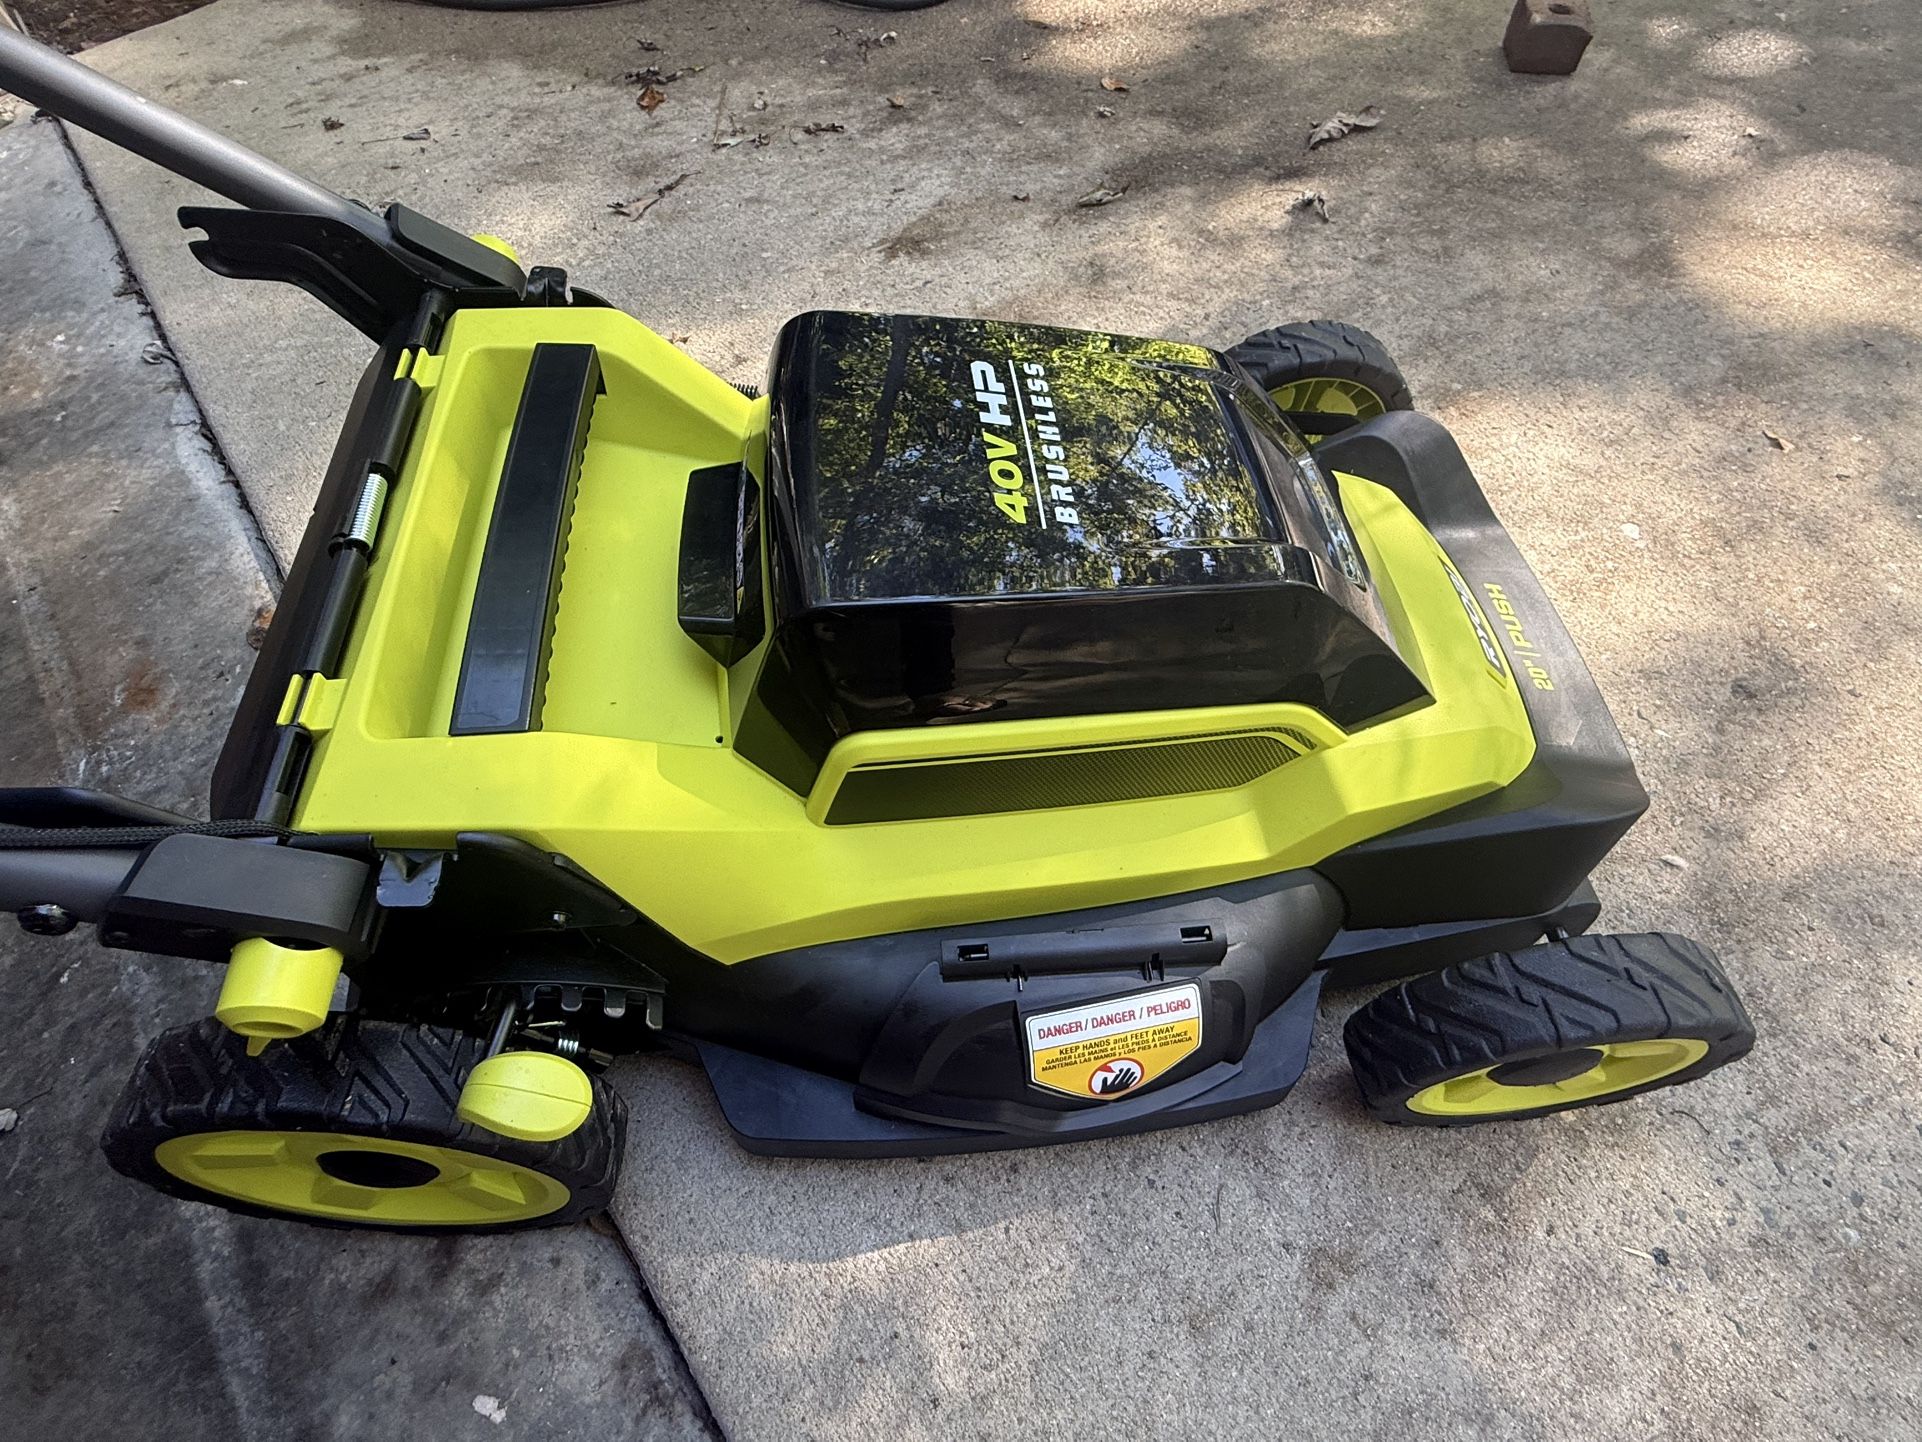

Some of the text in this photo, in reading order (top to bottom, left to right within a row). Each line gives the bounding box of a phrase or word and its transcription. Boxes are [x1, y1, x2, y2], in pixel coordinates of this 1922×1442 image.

[970, 360, 1028, 524] 40V HP
[1023, 362, 1079, 525] BRUSHLESS
[1483, 582, 1533, 648] PUSH
[1038, 1021, 1083, 1040] DANGER
[1091, 1010, 1136, 1029] DANGER
[1147, 998, 1191, 1018] PELIGRO
[1041, 1061, 1078, 1072] MANTENGA
[1079, 1057, 1092, 1065] LAS
[1094, 1053, 1118, 1062] MANOS
[1137, 1044, 1152, 1052] PIES
[1159, 1036, 1192, 1048] DISTANCIA
[1045, 1055, 1072, 1065] GARDER
[1087, 1048, 1109, 1057] MAINS
[1131, 1038, 1150, 1047] PIEDS
[1157, 1030, 1188, 1042] DISTANCE
[1059, 1025, 1175, 1056] KEEP HANDS and FEET AWAY
